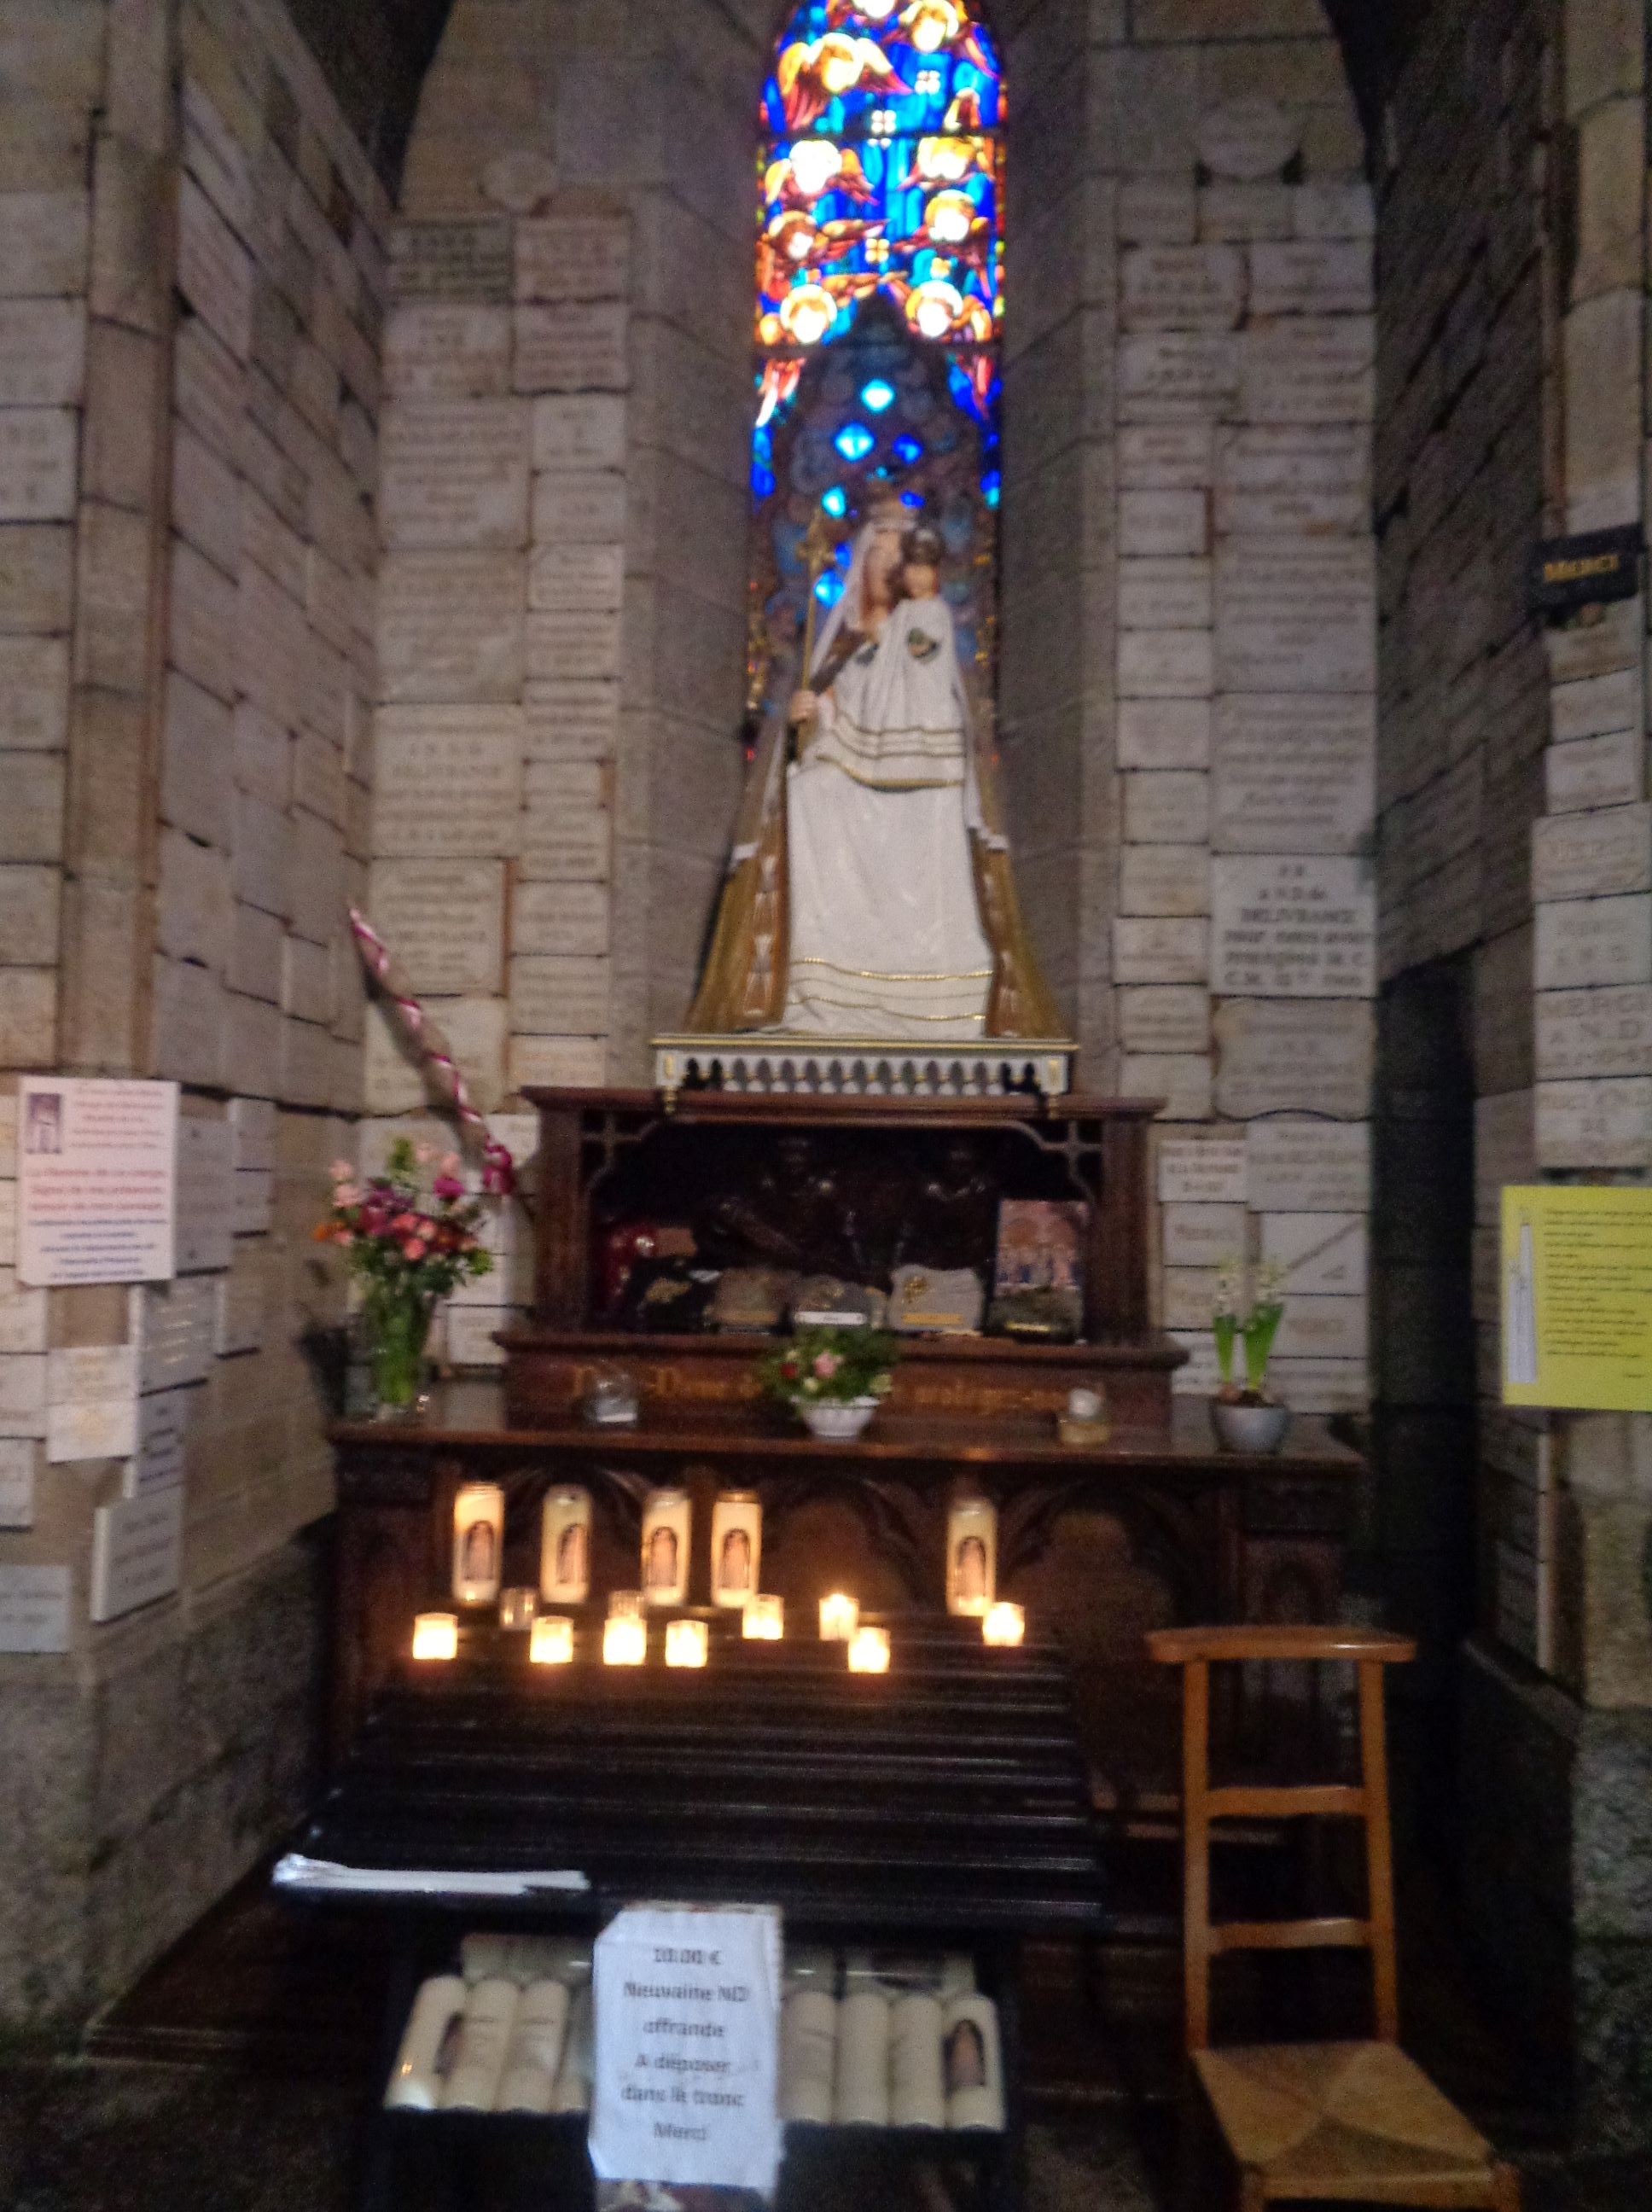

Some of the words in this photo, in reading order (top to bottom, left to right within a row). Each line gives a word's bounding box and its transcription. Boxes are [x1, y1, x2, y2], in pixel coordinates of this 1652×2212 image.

[709, 1949, 722, 1966] €
[624, 1982, 712, 2001] Neuvaine
[718, 1984, 750, 2003] ND
[643, 2018, 725, 2038] offrande
[655, 2052, 731, 2074] déposer
[623, 2083, 666, 2103] dans
[671, 2086, 688, 2104] le
[694, 2090, 747, 2107] tronc
[654, 2122, 707, 2141] Merci
